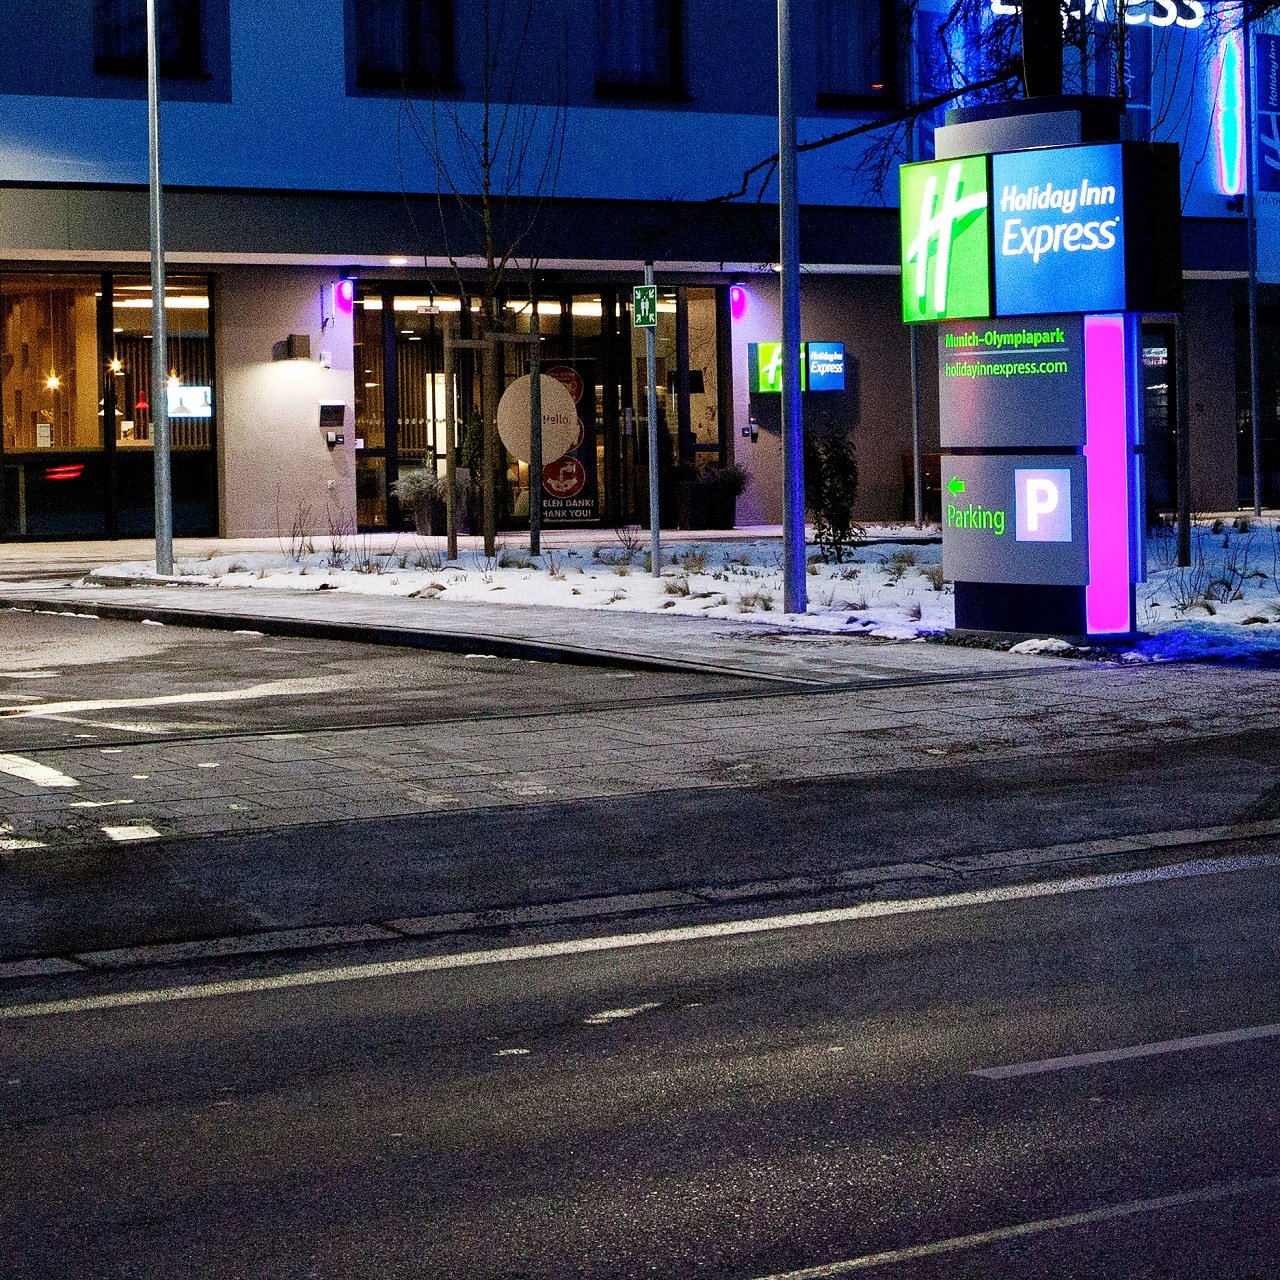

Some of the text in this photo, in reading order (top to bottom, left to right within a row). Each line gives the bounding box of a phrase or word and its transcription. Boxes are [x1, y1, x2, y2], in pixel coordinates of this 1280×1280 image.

[1268, 39, 1279, 107] Holiday Inn
[1001, 179, 1115, 214] Holiday Inn
[1002, 217, 1118, 264] Express
[945, 327, 1065, 349] Munich-Olympiapark
[810, 361, 844, 376] Express
[945, 359, 1068, 380] holidayinnexpress.com
[569, 509, 592, 518] YOU!
[947, 504, 1006, 536] Parking
[1026, 478, 1059, 531] P
